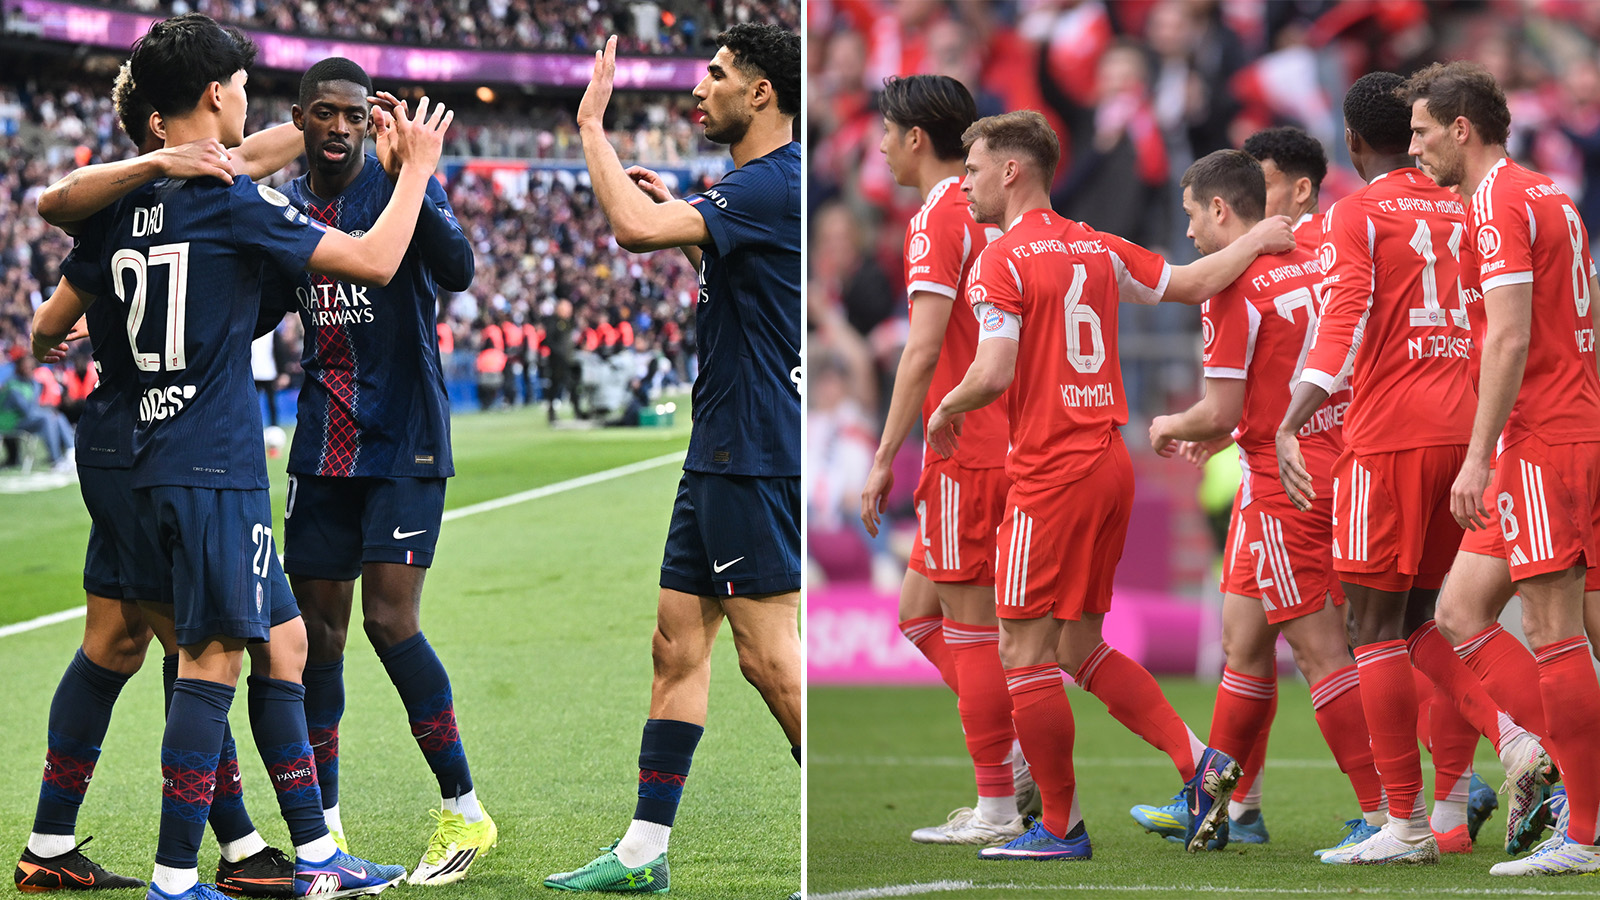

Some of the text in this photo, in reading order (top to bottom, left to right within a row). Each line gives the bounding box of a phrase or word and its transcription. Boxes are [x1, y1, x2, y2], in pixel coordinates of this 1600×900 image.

[1378, 200, 1396, 212] FC
[1396, 198, 1434, 212] BAYERN
[1525, 187, 1542, 200] FC
[132, 202, 164, 237] DRO
[1012, 245, 1030, 259] FC
[1029, 239, 1068, 255] BAYERN
[1561, 204, 1590, 317] 8
[1252, 274, 1270, 291] FC
[1268, 263, 1304, 283] BAYERN
[1409, 219, 1471, 330] 11
[111, 241, 190, 372] 27
[295, 283, 372, 315] QATAR
[1064, 263, 1106, 374] 6
[1060, 382, 1115, 408] KIMMIH
[1497, 491, 1520, 542] 8
[251, 523, 273, 579] 27
[276, 767, 311, 782] PARIS
